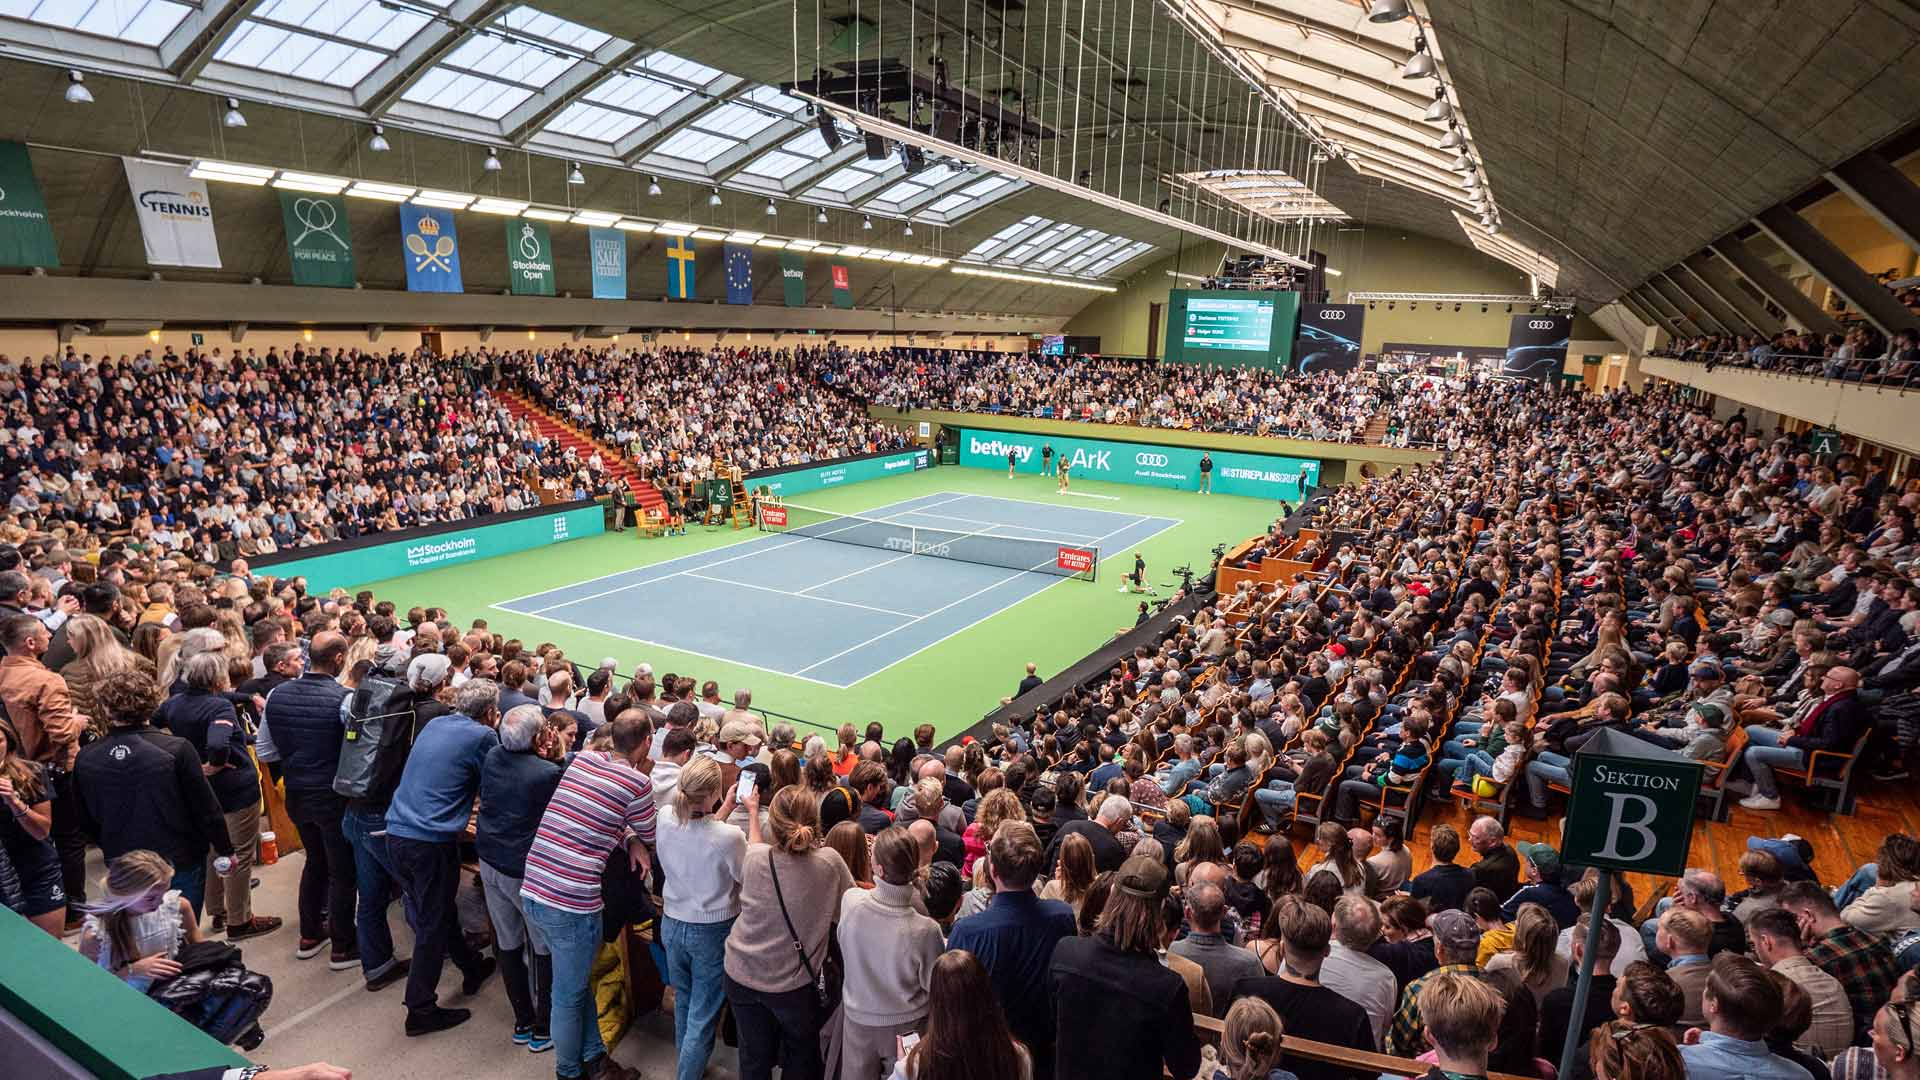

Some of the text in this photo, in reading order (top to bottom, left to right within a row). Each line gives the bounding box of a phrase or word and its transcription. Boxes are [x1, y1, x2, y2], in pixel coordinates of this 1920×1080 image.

[148, 201, 210, 217] TENNIS
[512, 260, 551, 272] Stockholm
[523, 269, 543, 280] Open
[970, 437, 1034, 463] betway
[1815, 437, 1833, 454] A
[1071, 448, 1112, 471] ArK
[1230, 466, 1310, 486] STUREPLANSGRUPPN
[424, 537, 476, 556] Stockholm
[1060, 551, 1090, 564] Emirates
[1591, 792, 1658, 861] B
